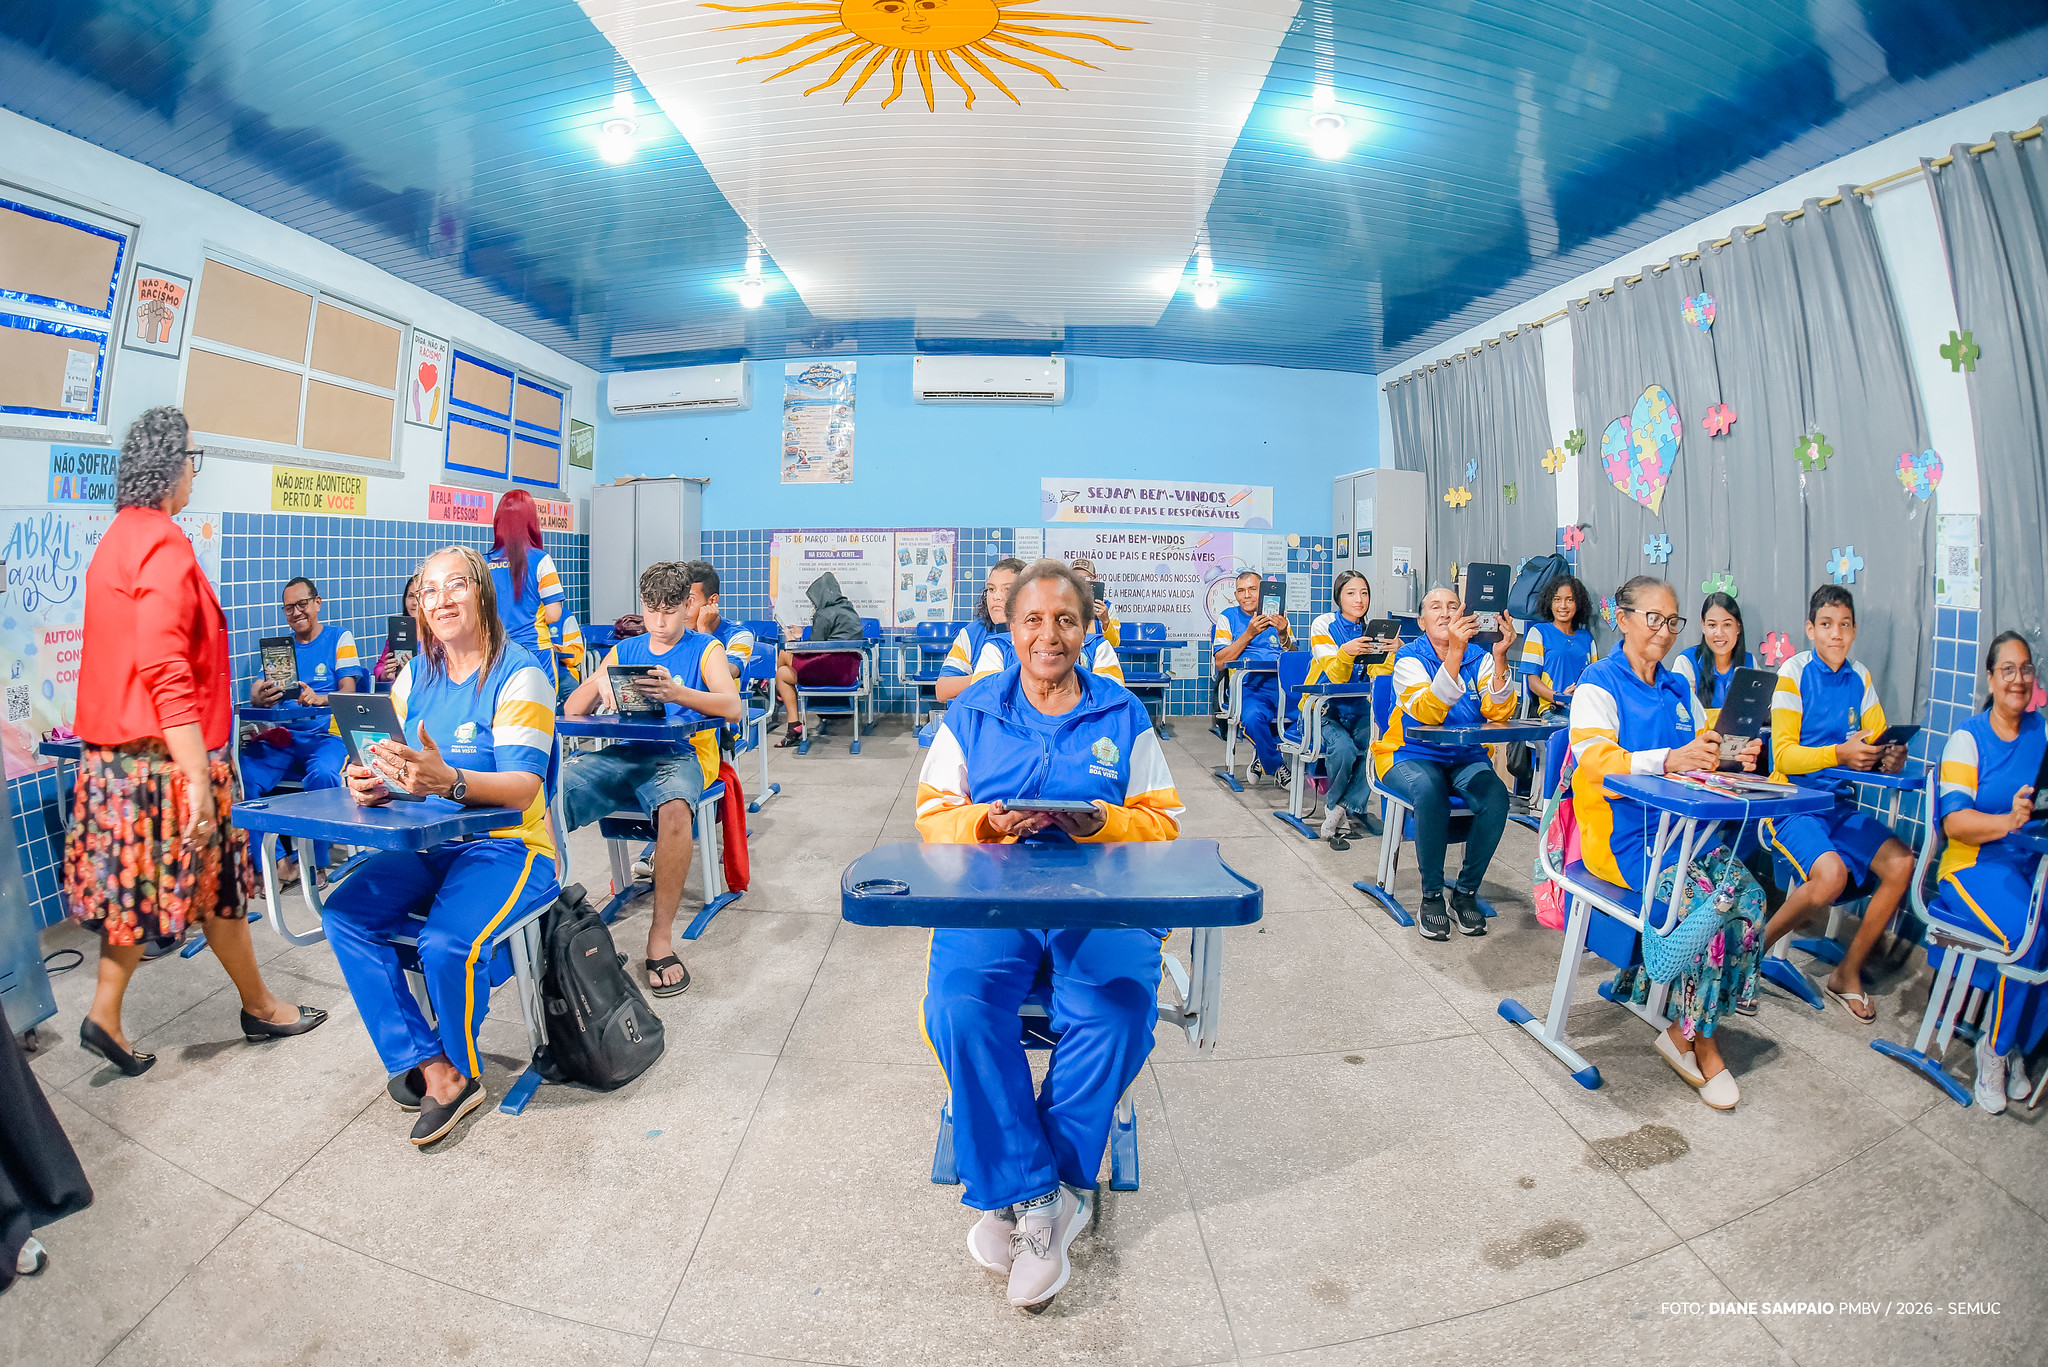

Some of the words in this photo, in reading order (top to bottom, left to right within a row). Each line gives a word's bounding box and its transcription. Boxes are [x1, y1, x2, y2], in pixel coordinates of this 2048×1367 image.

[164, 282, 175, 293] AO
[141, 289, 179, 307] RACISMO
[419, 346, 441, 362] RACISMO
[77, 452, 117, 475] SOFRA
[53, 476, 88, 499] FALE
[88, 483, 107, 500] COM
[276, 472, 294, 489] NÃO
[294, 476, 314, 491] DEIXE
[316, 474, 362, 495] ACONTECER
[283, 491, 310, 508] PERTO
[314, 494, 323, 507] DE
[327, 494, 355, 510] VOCÊ
[436, 491, 451, 504] FALA
[1088, 486, 1136, 500] SEJAM
[1140, 488, 1226, 504] BEM-VINDOS
[453, 506, 479, 521] PESSOAS
[1074, 504, 1117, 515] REUNIÃO
[1120, 507, 1131, 515] DE
[1134, 506, 1157, 516] PAIS
[1160, 507, 1165, 516] E
[1168, 506, 1240, 519] RESPONSÁVEIS
[548, 516, 568, 529] AMIGOS
[785, 535, 791, 543] 15
[794, 535, 802, 543] DE
[804, 535, 828, 544] MARÇO
[836, 535, 847, 543] DIA
[850, 535, 858, 543] DA
[861, 535, 887, 543] ESCOLA
[1095, 534, 1126, 544] SEJAM
[1128, 534, 1185, 545] BEM-VINDOS
[1064, 549, 1103, 560] REUNIÃO
[1106, 551, 1117, 560] DE
[1119, 551, 1139, 561] PAIS
[1141, 551, 1147, 560] E
[1149, 550, 1215, 562] RESPONSÁVEIS
[1108, 573, 1121, 582] QUE
[1122, 573, 1159, 582] DEDICAMOS
[1160, 574, 1173, 582] AOS
[1174, 574, 1201, 583] NOSSOS
[1109, 587, 1113, 597] É
[1114, 589, 1118, 597] A
[1119, 589, 1150, 599] HERANÇA
[1152, 589, 1166, 598] MAIS
[1168, 589, 1195, 598] VALIOSA
[1133, 604, 1156, 613] DEIXAR
[1158, 604, 1175, 613] PARA
[44, 629, 83, 645] AUTON
[1089, 768, 1102, 776] BOA
[1103, 771, 1118, 780] VISTA
